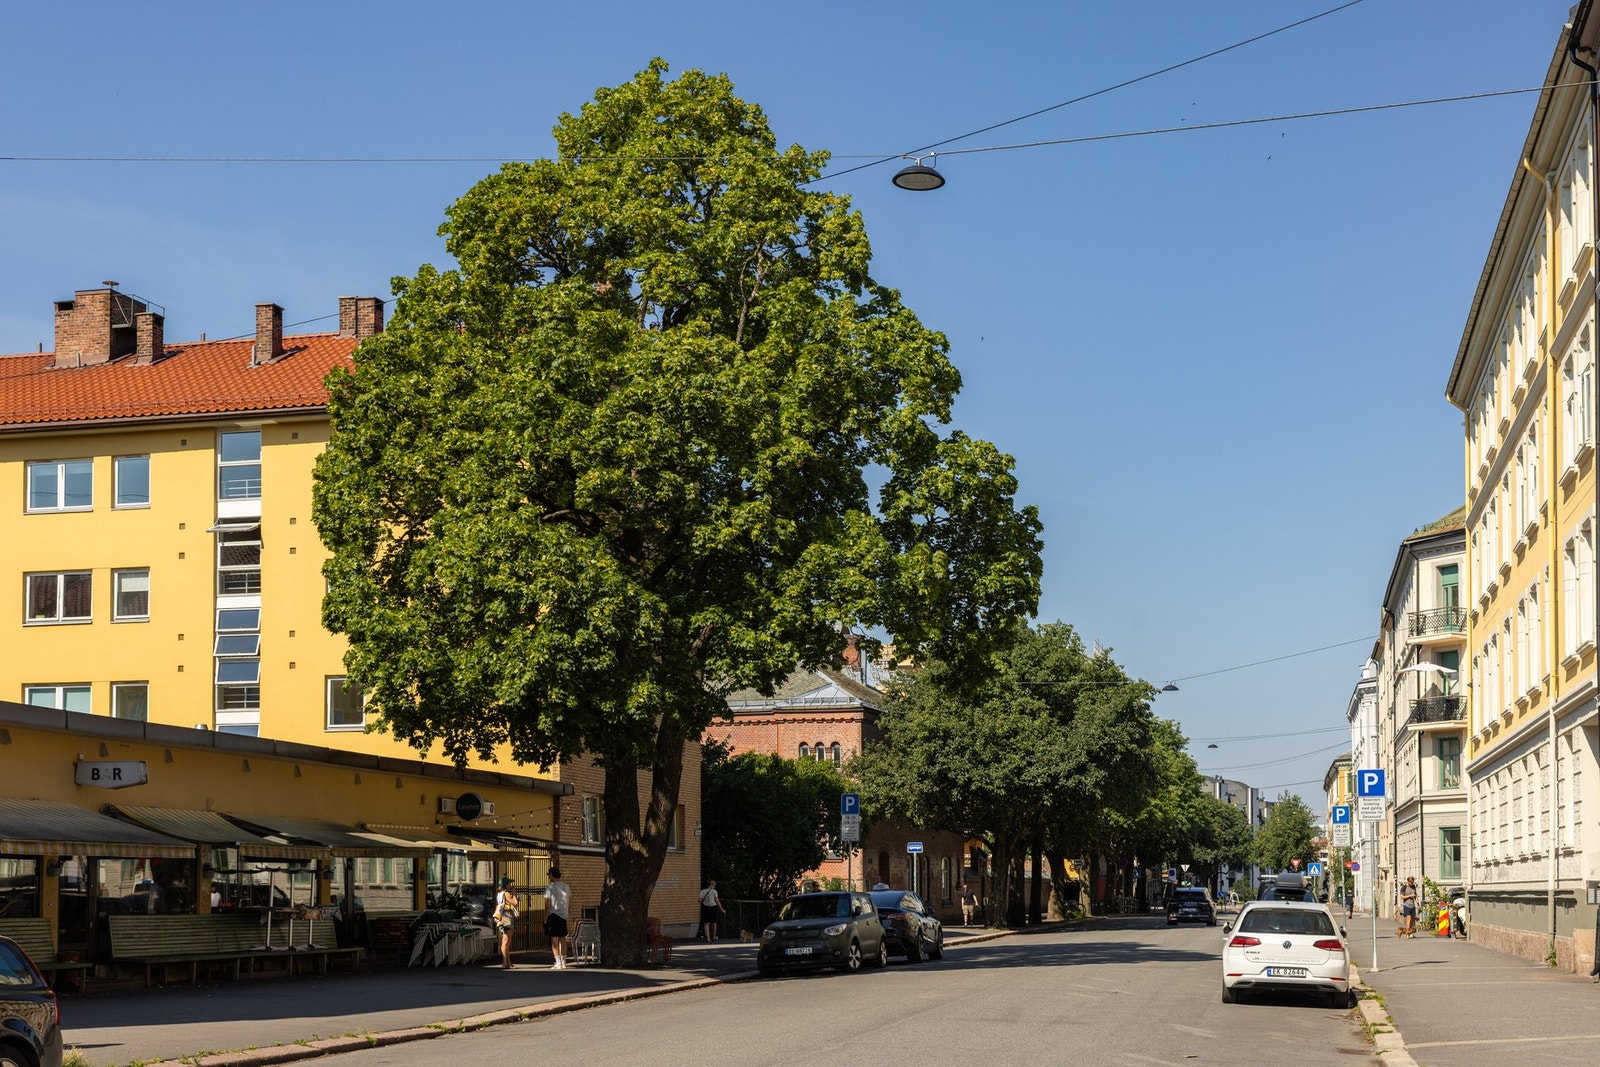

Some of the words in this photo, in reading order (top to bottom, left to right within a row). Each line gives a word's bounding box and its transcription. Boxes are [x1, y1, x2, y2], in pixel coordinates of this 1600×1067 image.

[1364, 772, 1379, 794] P
[845, 796, 855, 812] P
[1336, 808, 1346, 822] P
[1283, 968, 1305, 976] 82644
